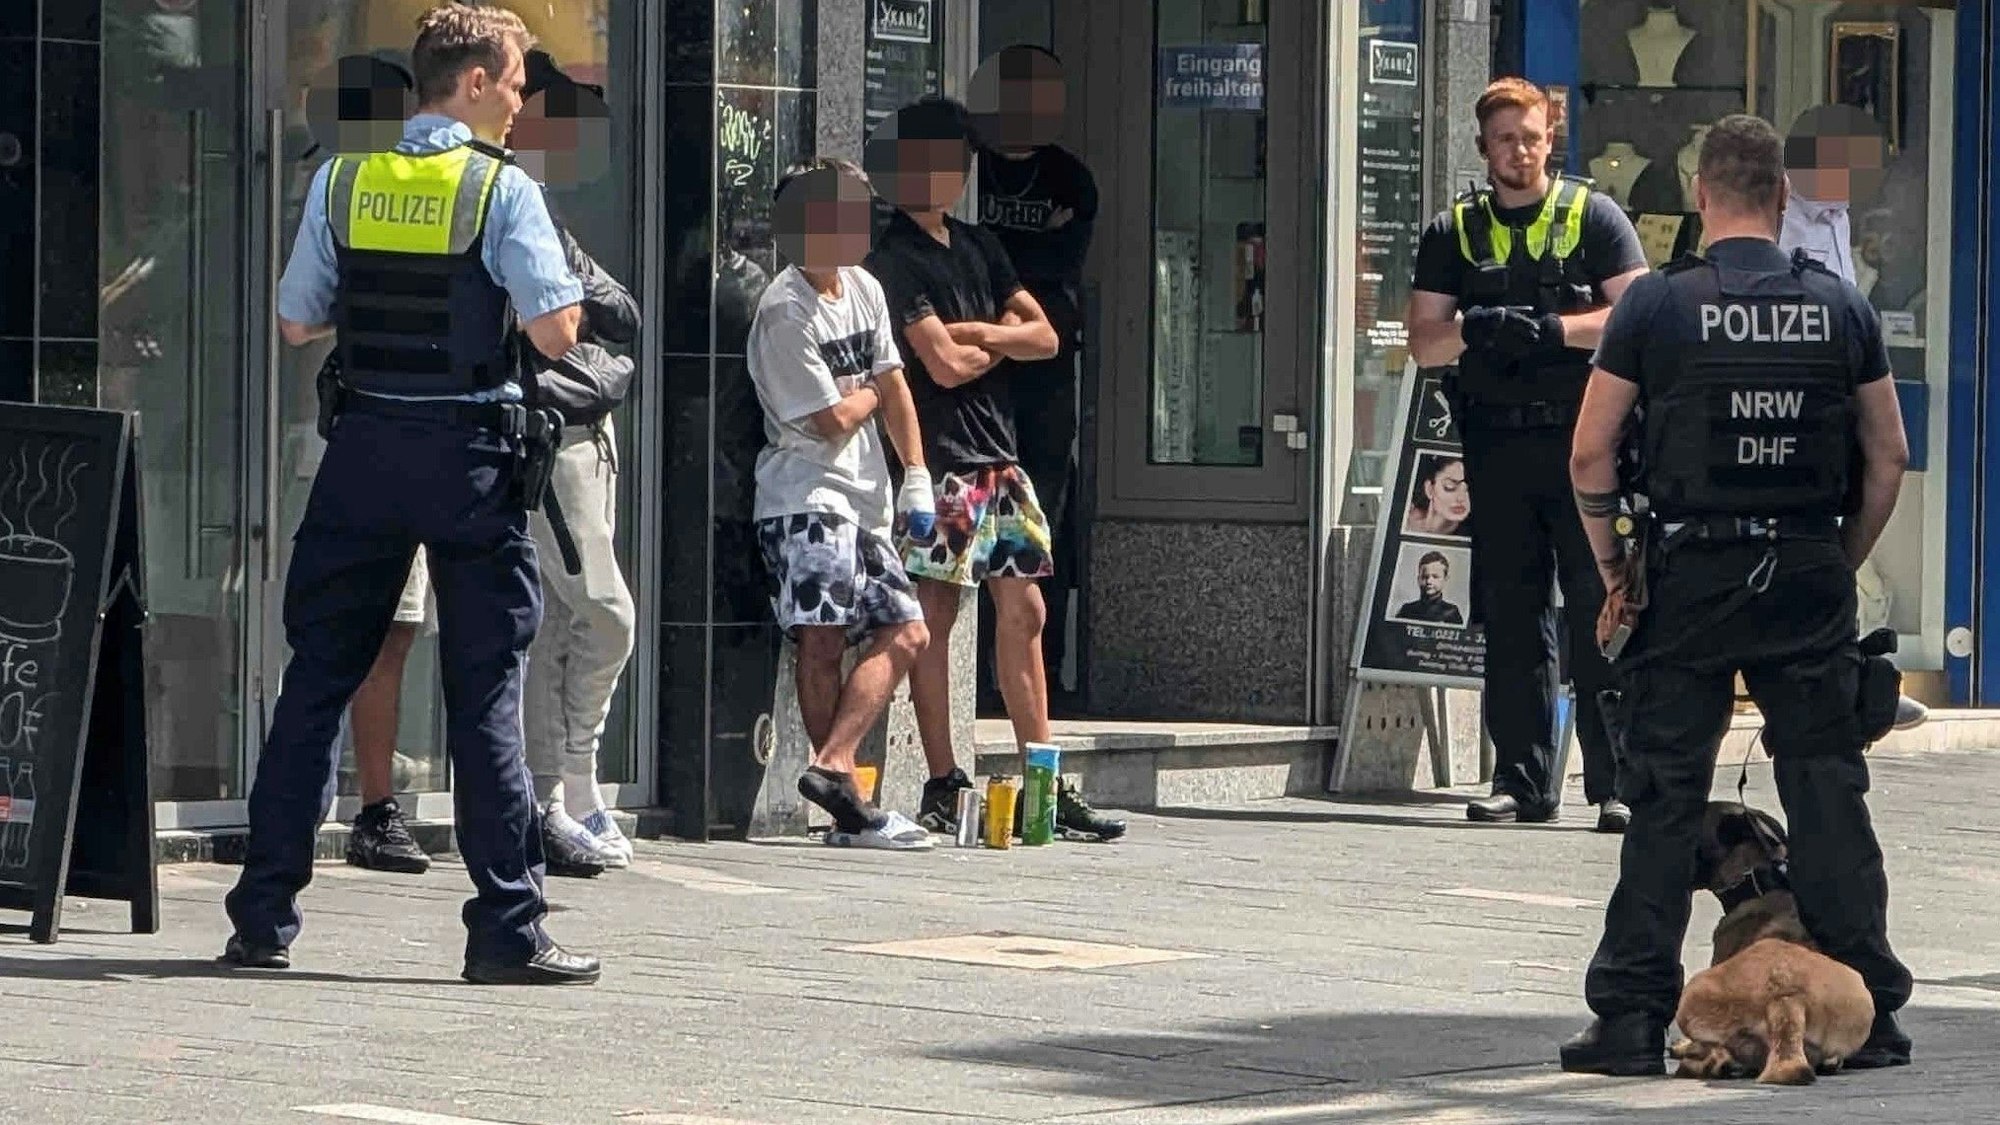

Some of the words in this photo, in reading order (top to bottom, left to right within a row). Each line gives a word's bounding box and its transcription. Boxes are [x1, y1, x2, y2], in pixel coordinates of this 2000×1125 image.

[1177, 54, 1261, 77] Eingang
[1165, 78, 1264, 97] freihalten
[357, 191, 447, 226] POLIZEI
[1701, 304, 1831, 342] POLIZEI
[1731, 391, 1804, 419] NRW
[1737, 436, 1797, 465] DHF
